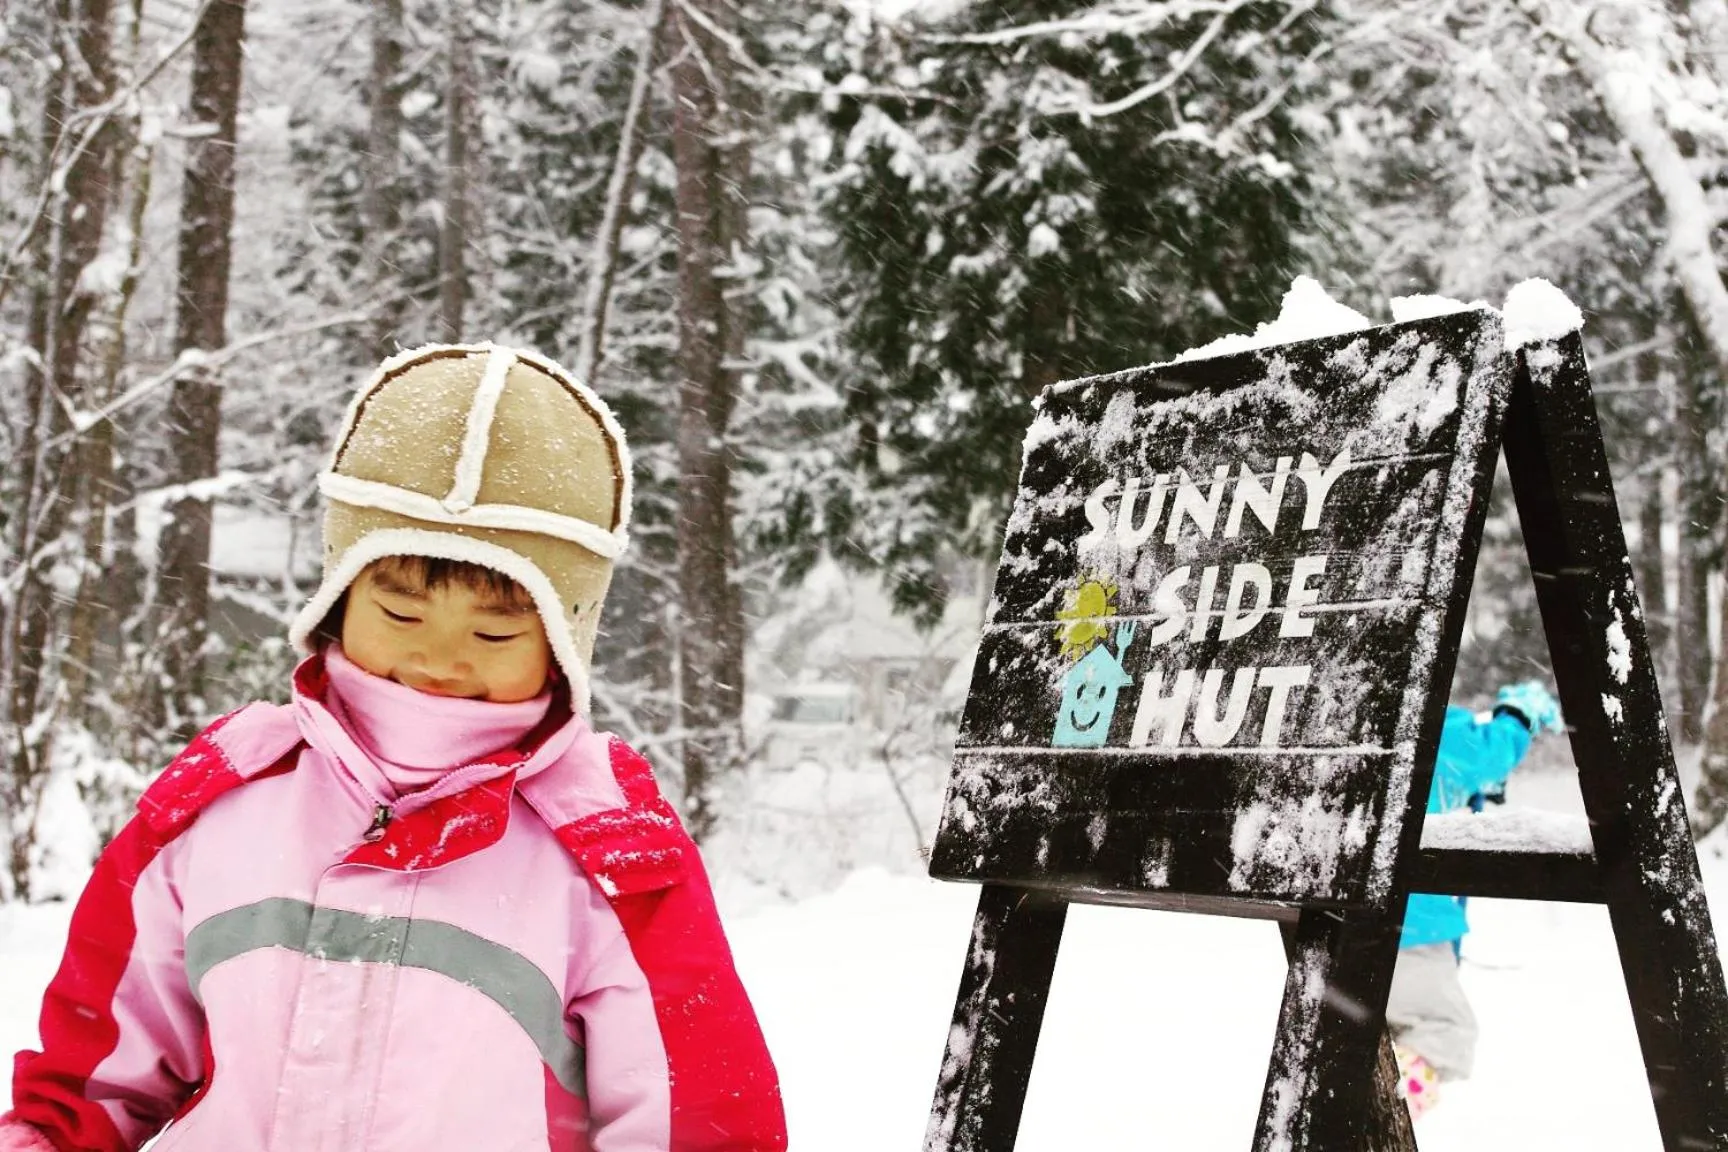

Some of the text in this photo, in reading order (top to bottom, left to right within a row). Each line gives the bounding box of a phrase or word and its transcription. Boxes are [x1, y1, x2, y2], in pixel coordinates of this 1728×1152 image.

[1077, 449, 1352, 550] SUNNY
[1151, 556, 1327, 646] SIDE
[1129, 665, 1311, 747] HUT
